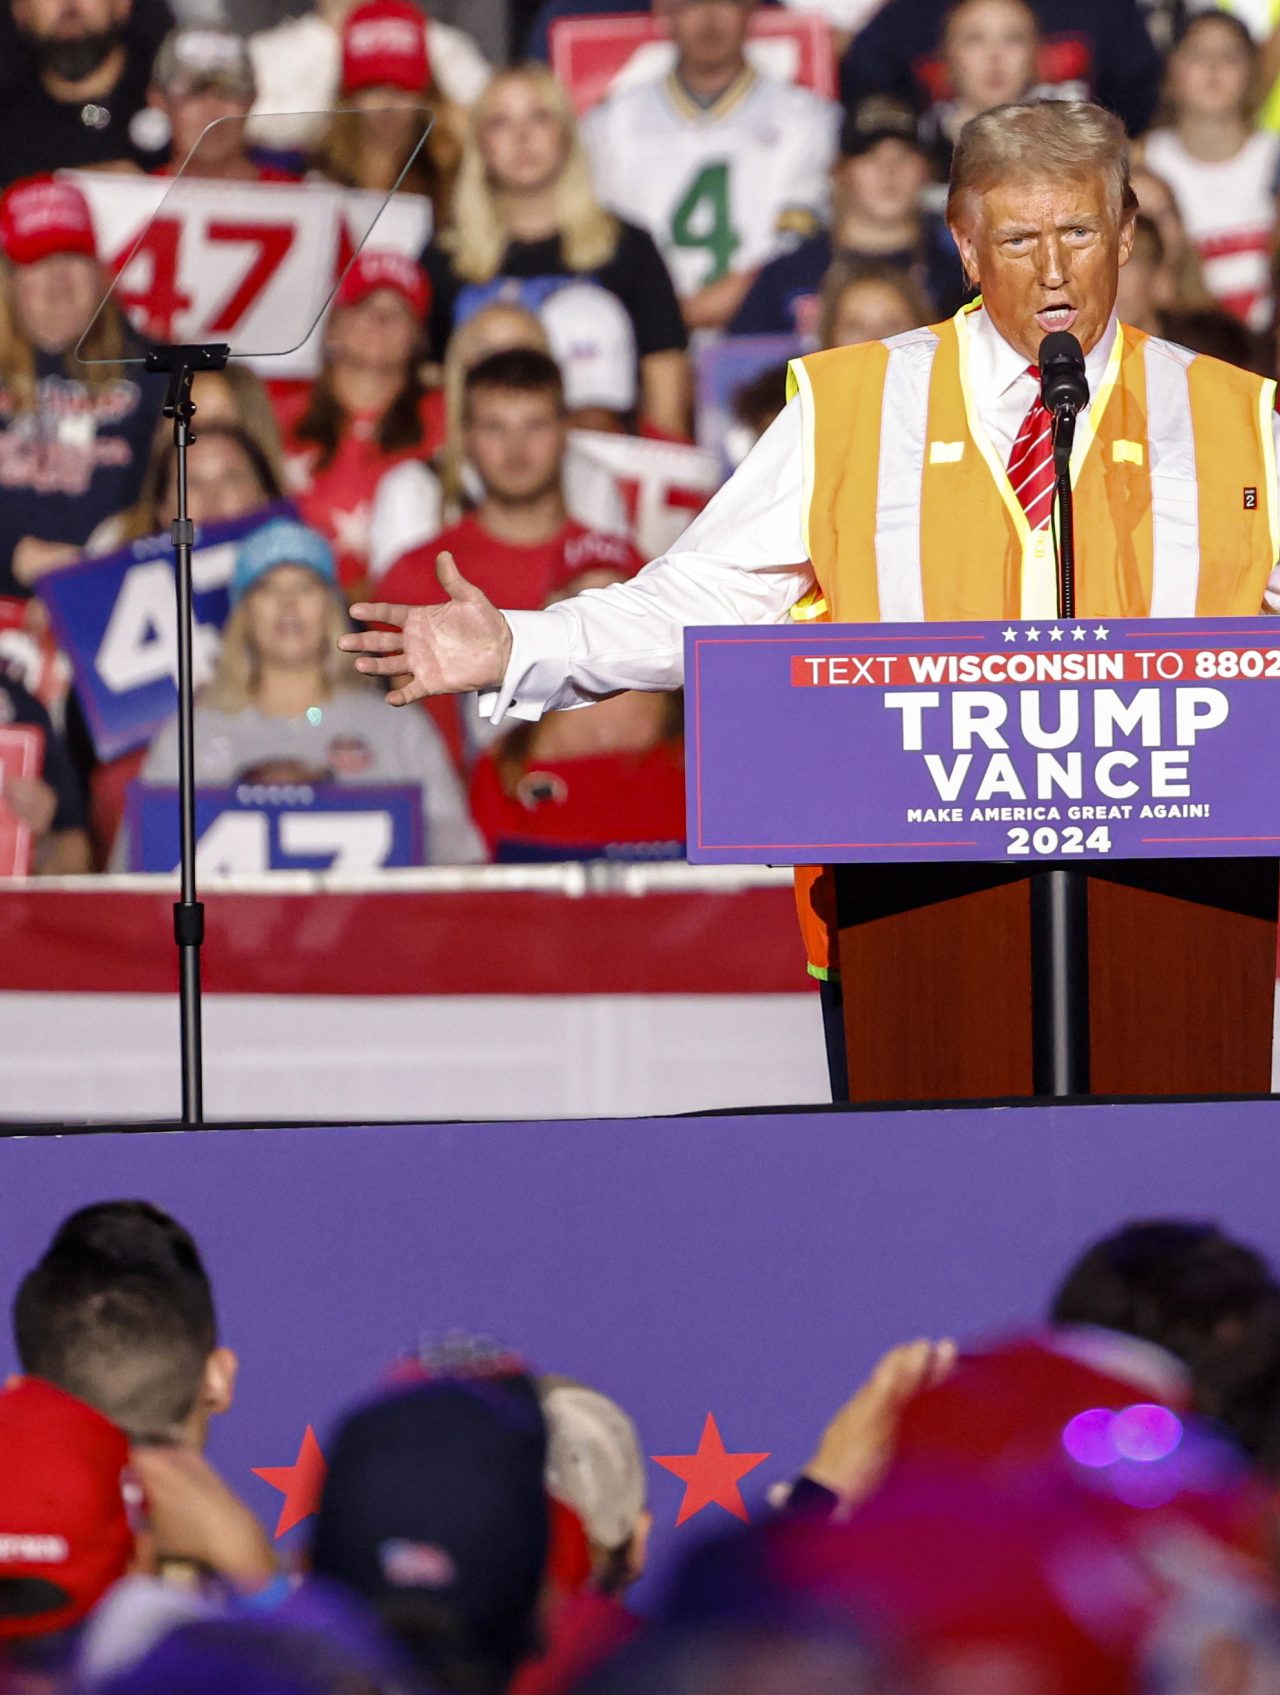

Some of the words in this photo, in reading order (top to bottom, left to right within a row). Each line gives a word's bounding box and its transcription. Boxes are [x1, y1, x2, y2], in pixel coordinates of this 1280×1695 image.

[672, 158, 742, 286] 4
[112, 216, 295, 341] 47
[804, 657, 898, 684] TEXT
[908, 653, 1124, 683] WISCONSIN
[1134, 652, 1184, 679] TO
[884, 687, 1230, 750] TRUMP
[923, 750, 1191, 802] VANCE
[907, 808, 963, 822] MAKE
[970, 805, 1061, 821] AMERICA
[1067, 804, 1133, 820] GREAT
[1140, 803, 1210, 818] AGAIN!
[1006, 826, 1112, 854] 2024
